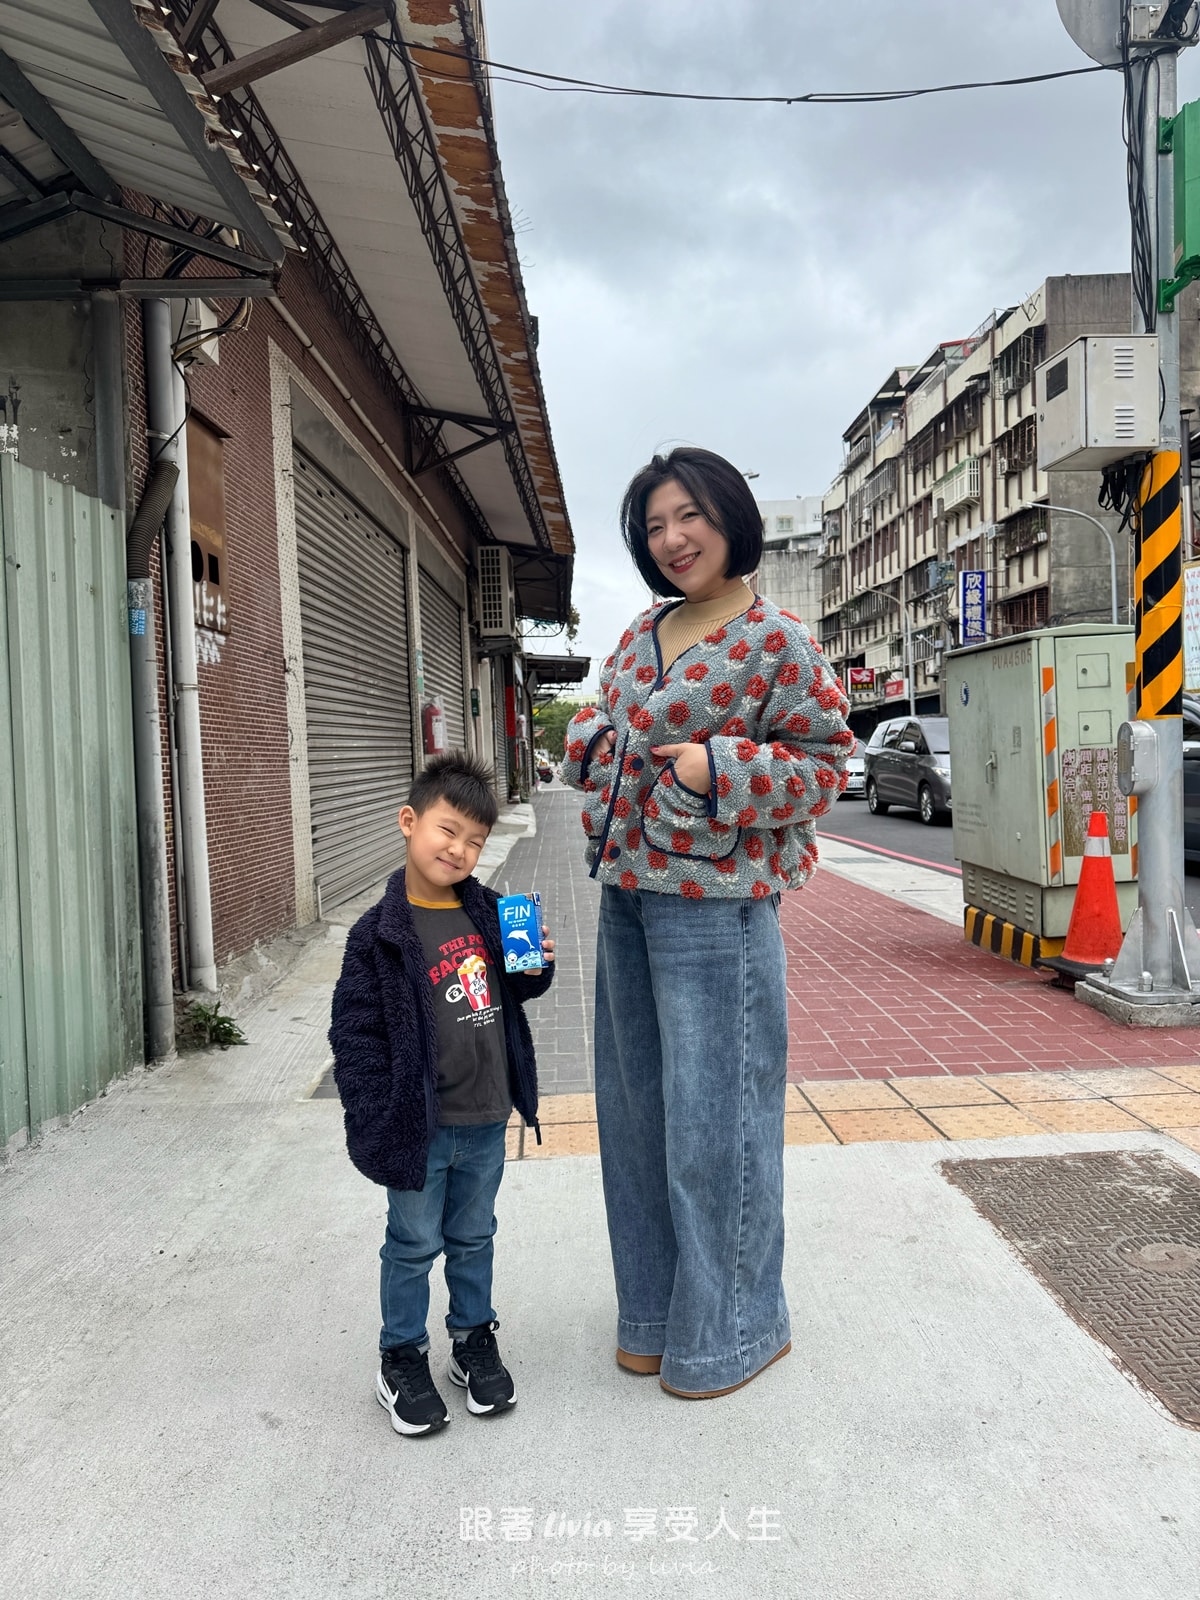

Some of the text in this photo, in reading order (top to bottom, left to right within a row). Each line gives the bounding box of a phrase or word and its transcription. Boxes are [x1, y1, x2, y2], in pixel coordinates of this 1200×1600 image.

[965, 573, 983, 637] 欣緣禮儀
[503, 904, 530, 921] FIN
[438, 934, 485, 956] THE PO
